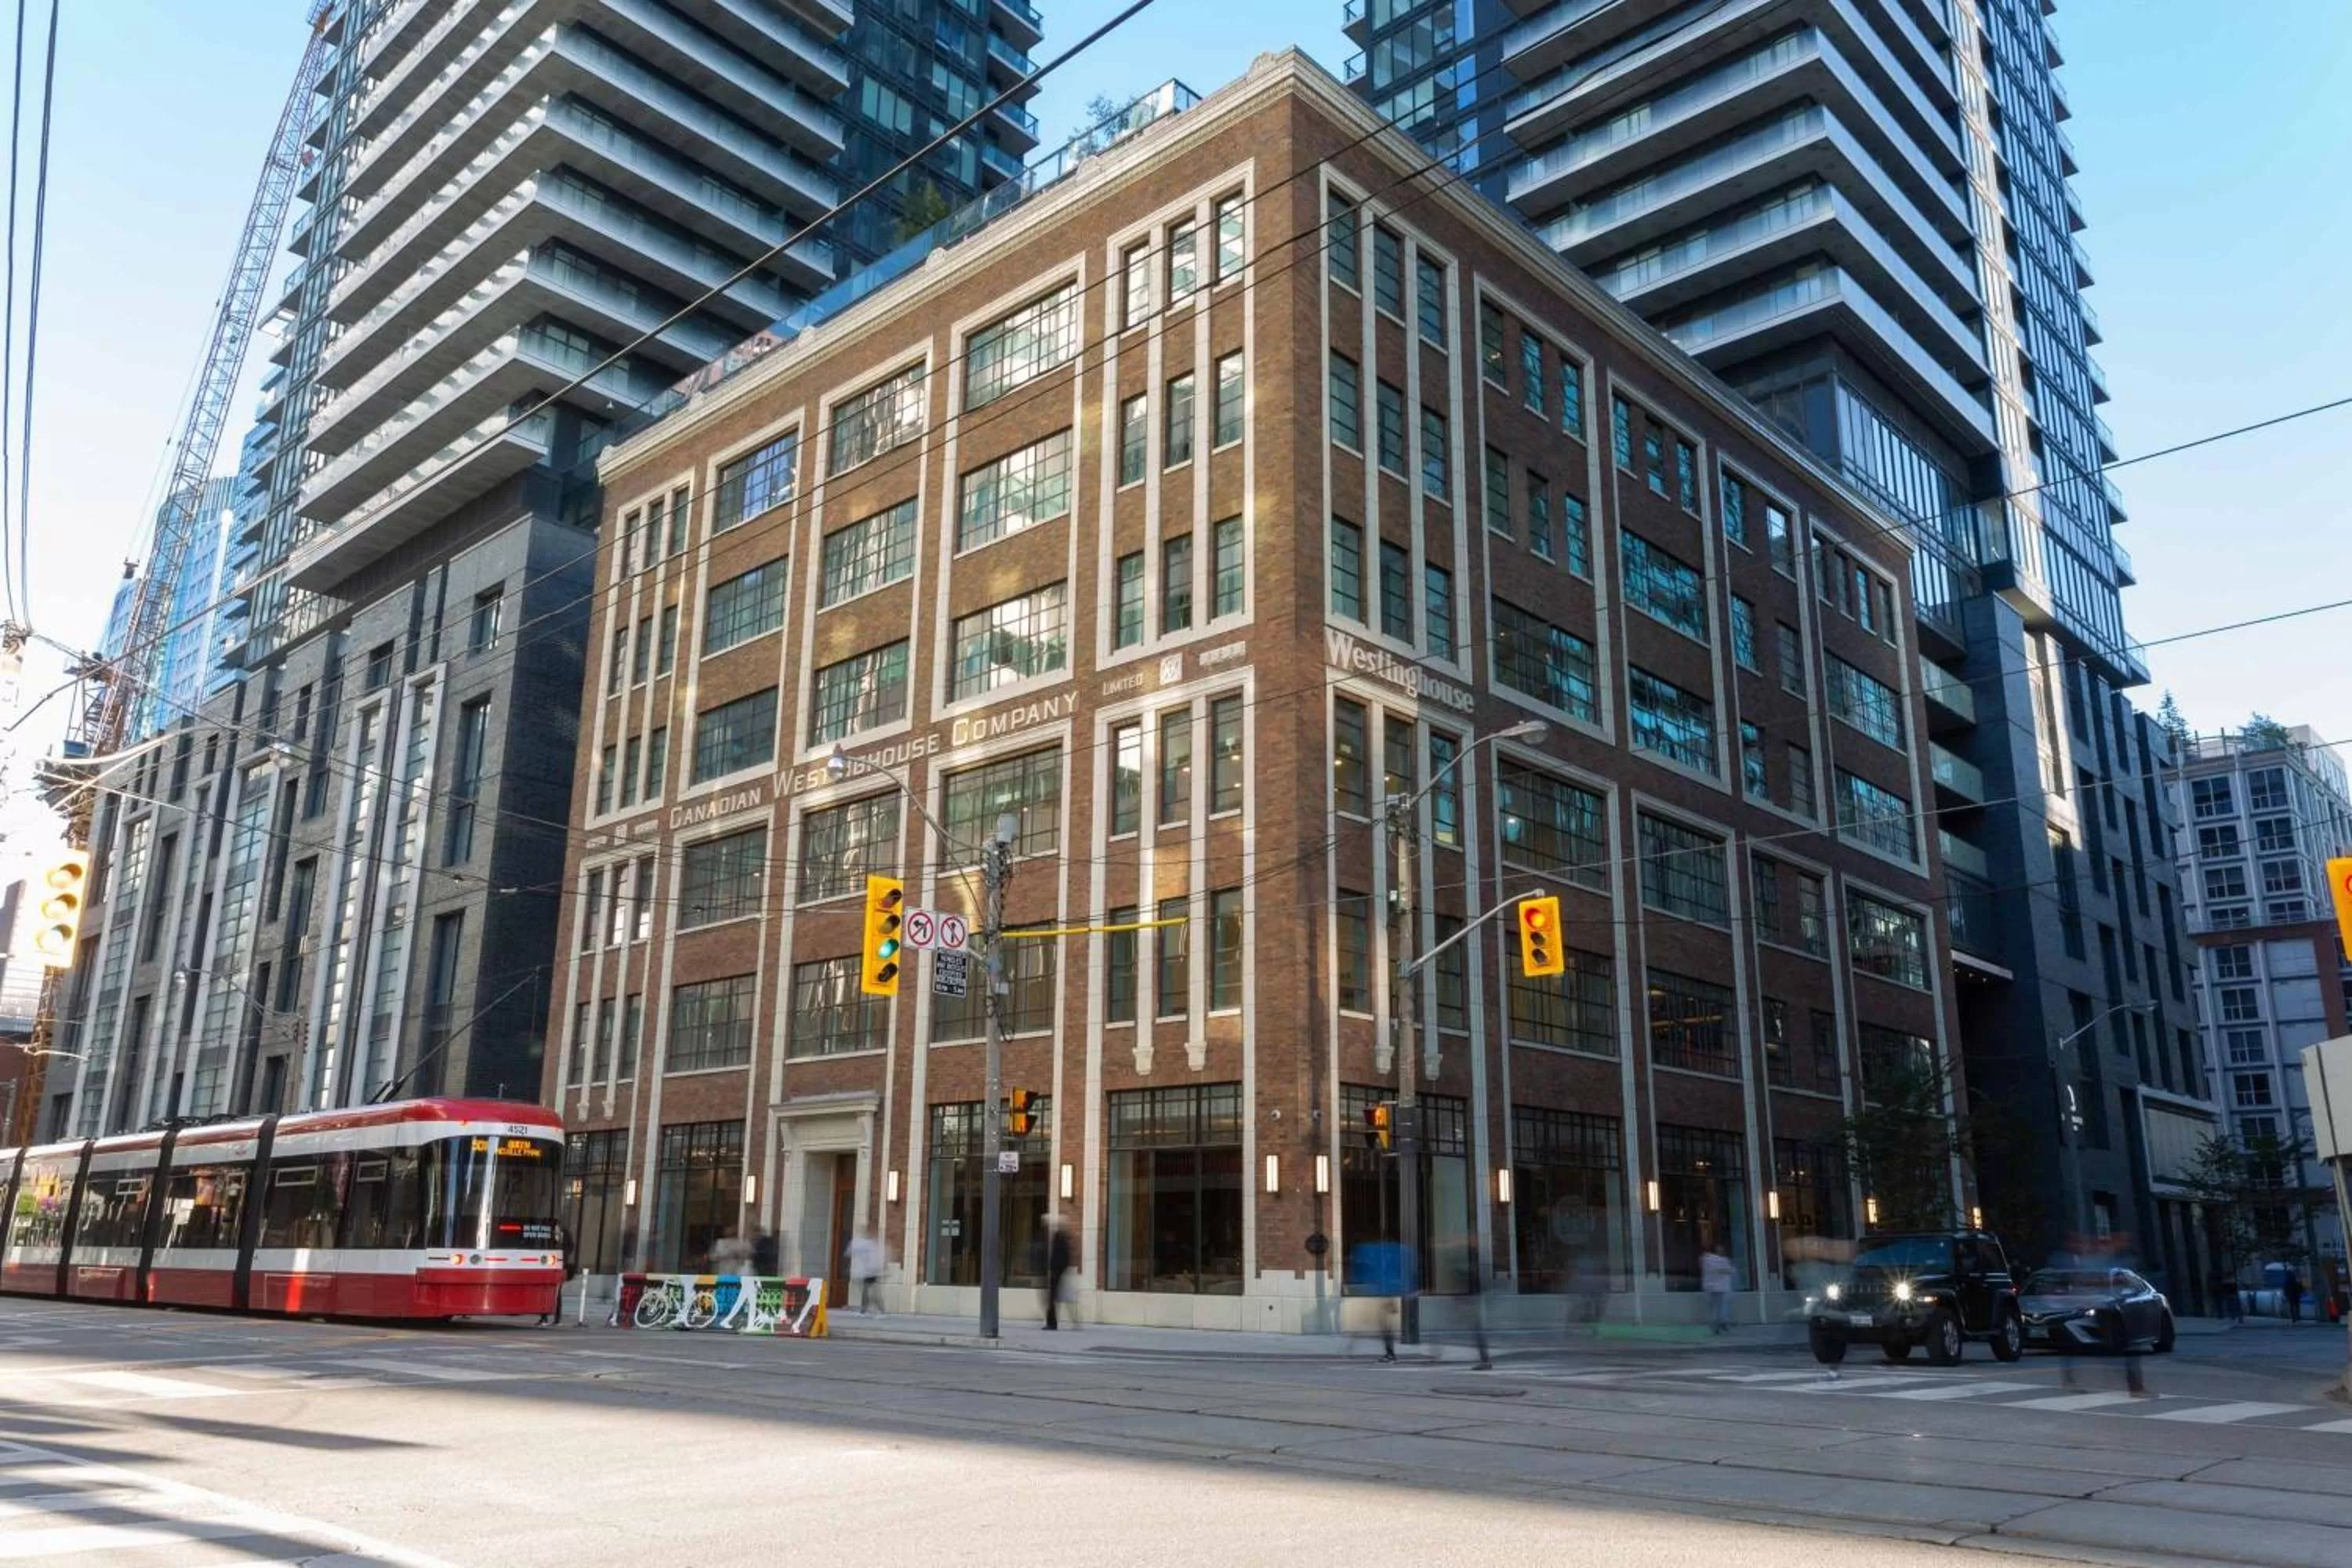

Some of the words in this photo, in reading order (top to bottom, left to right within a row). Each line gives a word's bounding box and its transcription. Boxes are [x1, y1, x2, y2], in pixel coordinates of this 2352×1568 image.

[1326, 630, 1475, 713] Westinghouse
[670, 787, 761, 829] CANADIAN
[772, 733, 940, 799] WESTGHOUSE
[951, 691, 1080, 746] COMPANY
[1102, 672, 1144, 696] LIMITED
